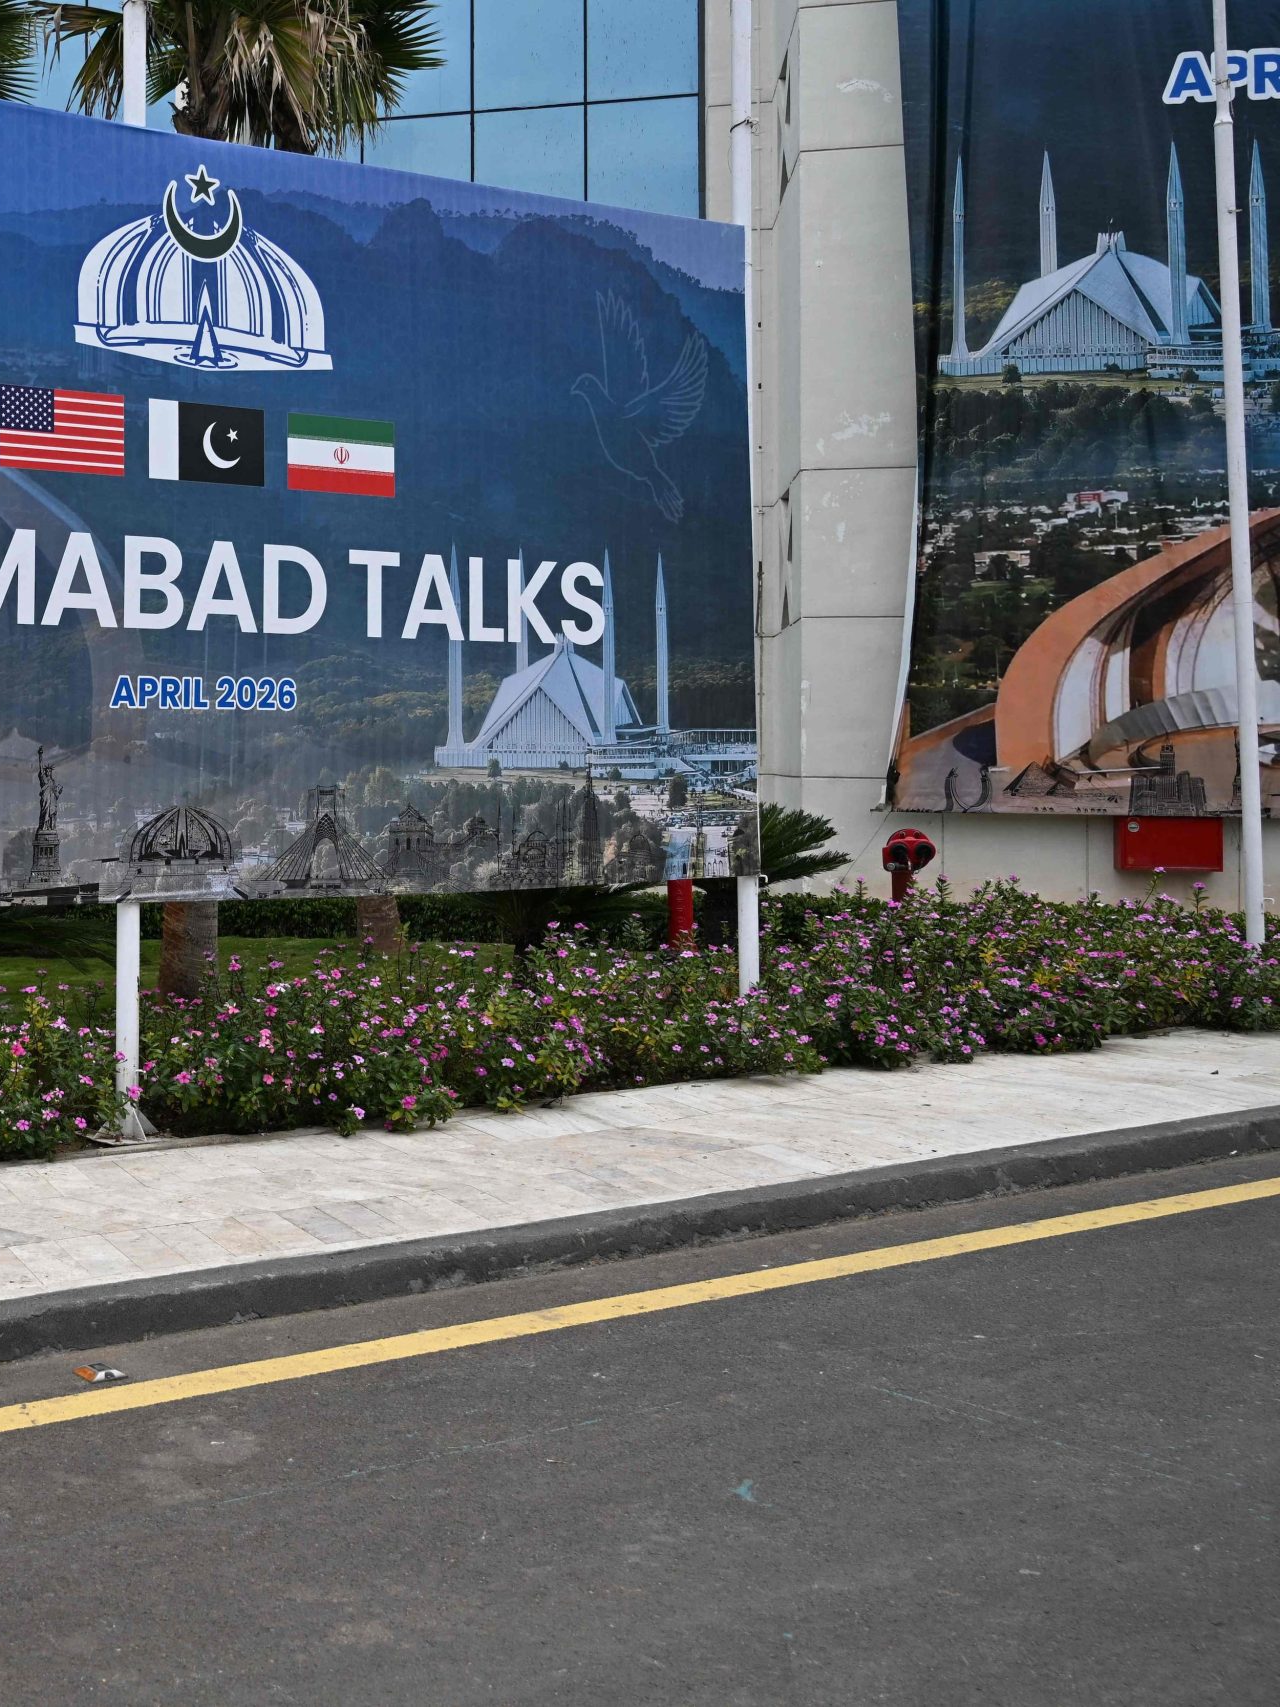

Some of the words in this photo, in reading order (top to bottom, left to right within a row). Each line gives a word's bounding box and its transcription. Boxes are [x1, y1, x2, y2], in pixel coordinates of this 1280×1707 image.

[349, 548, 606, 647] TALKS
[110, 675, 210, 710] APRIL
[215, 677, 297, 712] 2026
